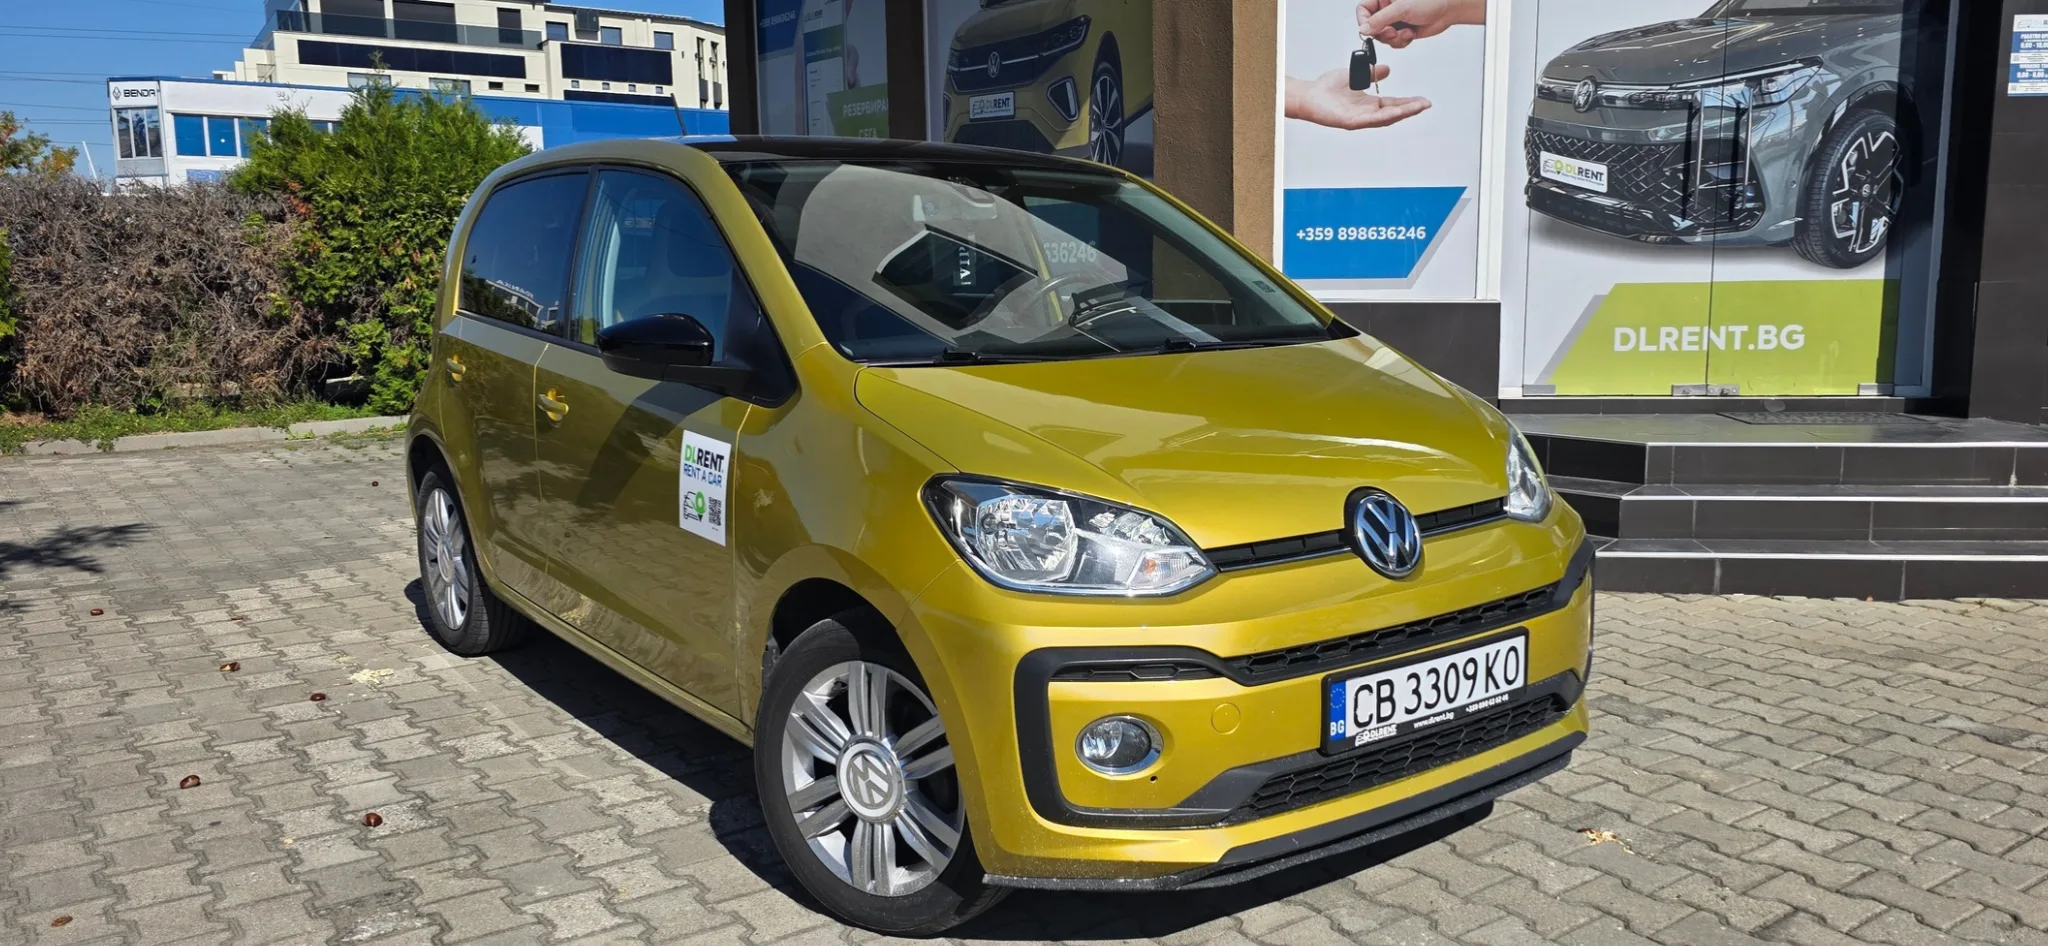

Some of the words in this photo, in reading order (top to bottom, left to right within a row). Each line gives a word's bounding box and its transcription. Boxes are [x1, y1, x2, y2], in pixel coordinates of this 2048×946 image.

[124, 89, 156, 97] BENDA
[1296, 227, 1334, 241] +359
[1338, 226, 1427, 241] 898636246
[1614, 324, 1805, 352] DLRENT.BG
[684, 444, 725, 473] DLRENT
[683, 463, 701, 481] RENT
[702, 472, 707, 482] A
[708, 472, 722, 488] CAR
[1353, 678, 1396, 729] CB
[1404, 657, 1479, 716] 3309
[1484, 645, 1520, 695] KO
[1330, 719, 1345, 737] BG
